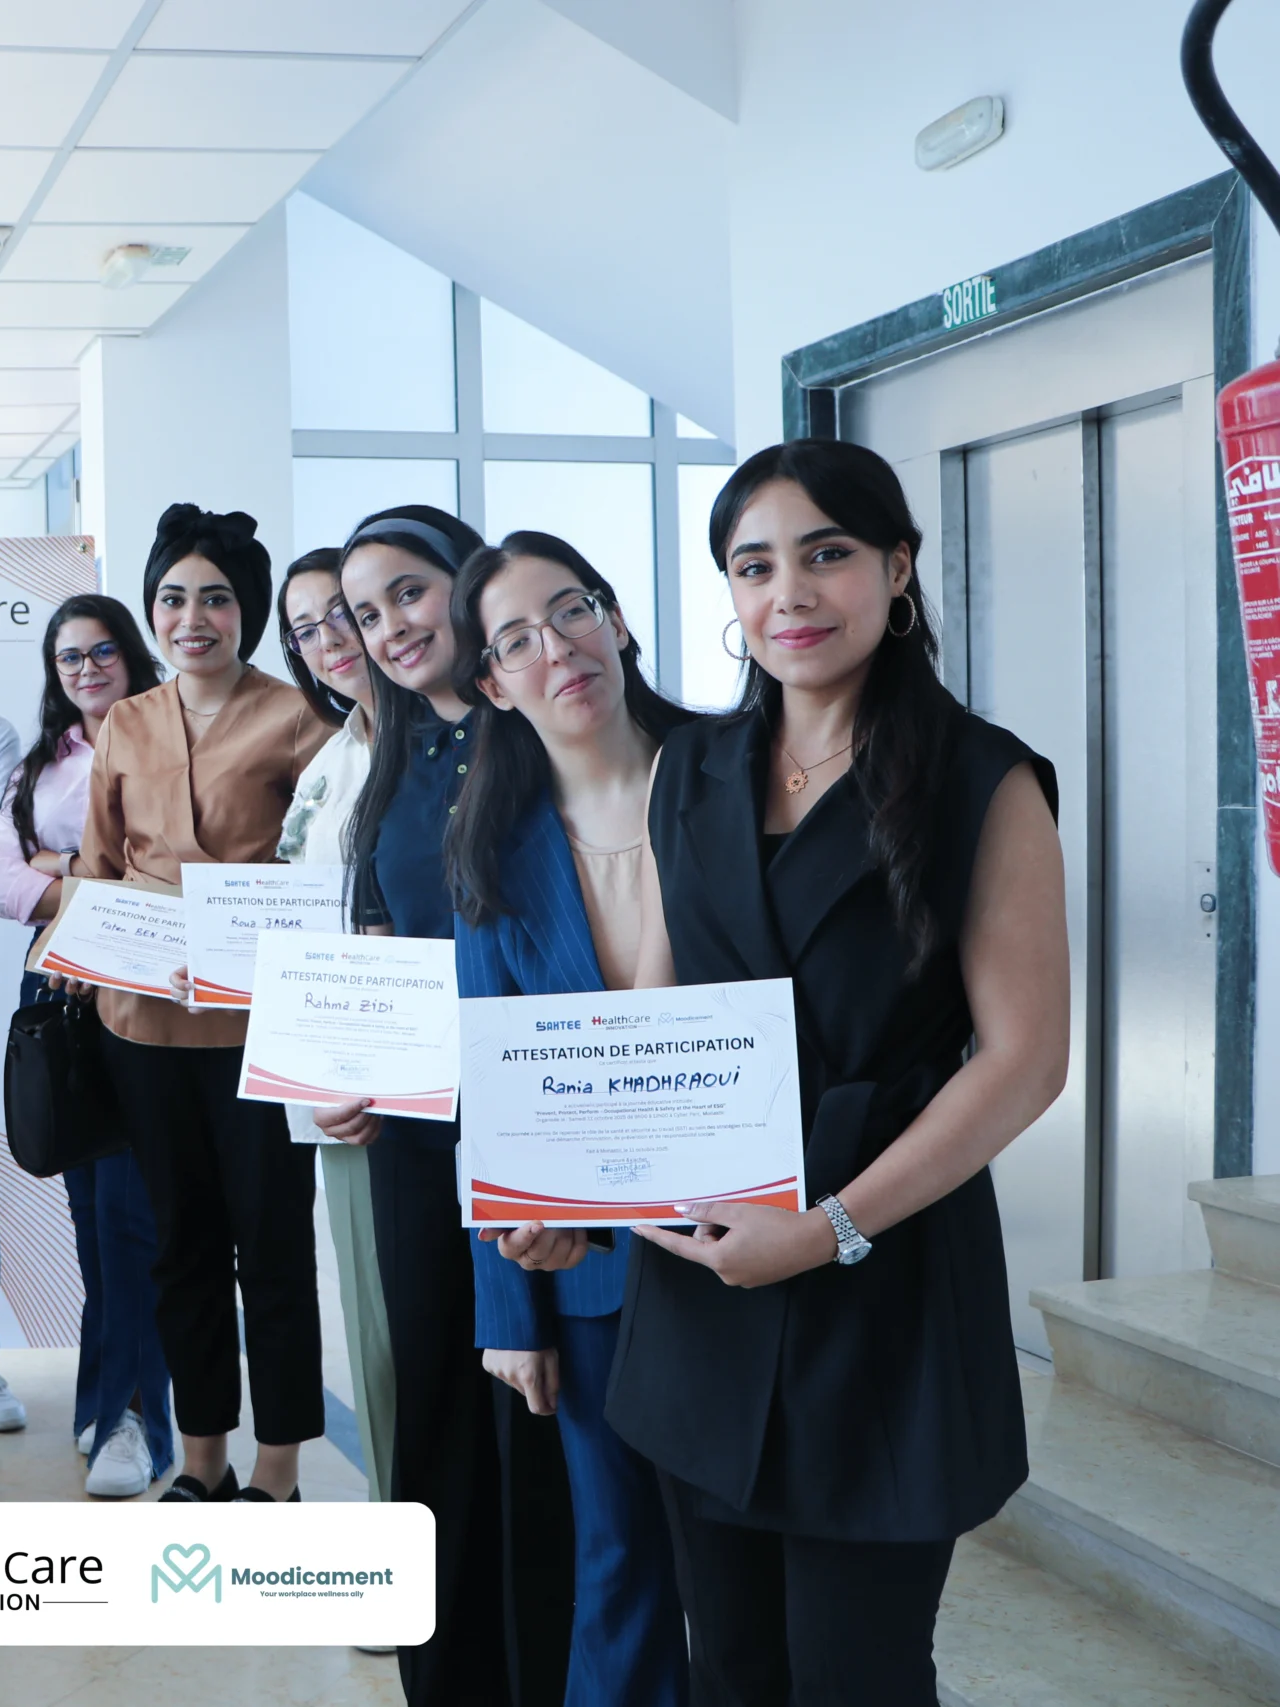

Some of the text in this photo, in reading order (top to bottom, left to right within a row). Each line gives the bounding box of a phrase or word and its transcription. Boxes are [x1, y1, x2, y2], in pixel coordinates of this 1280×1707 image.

[943, 275, 997, 329] SORTIE
[206, 896, 264, 906] ATTESTATION
[266, 898, 278, 906] DE
[91, 905, 187, 930] ATTESTATION DE PARTI
[134, 926, 158, 939] BEN
[280, 970, 445, 991] ATTESTATION DE PARTICIPATION
[304, 992, 351, 1011] Rahma
[536, 1020, 582, 1031] SAHTEE
[591, 1015, 651, 1026] HealthCare
[502, 1037, 755, 1061] ATTESTATION DE PARTICIPATION
[542, 1076, 593, 1095] Rania
